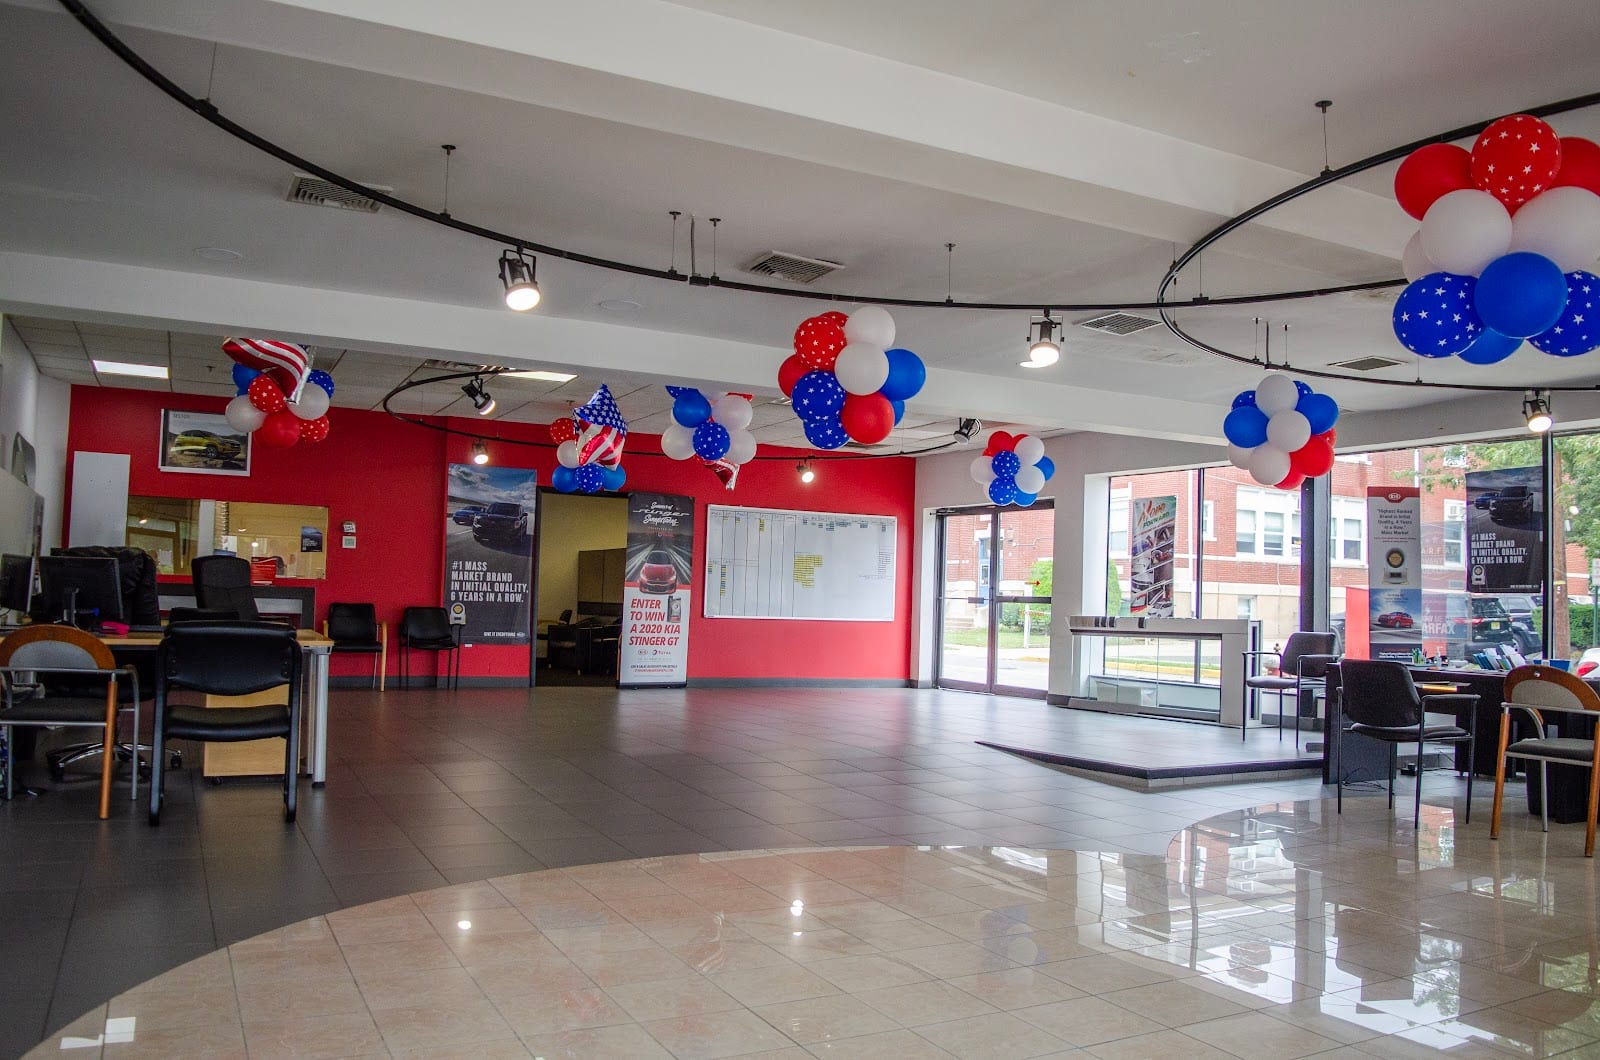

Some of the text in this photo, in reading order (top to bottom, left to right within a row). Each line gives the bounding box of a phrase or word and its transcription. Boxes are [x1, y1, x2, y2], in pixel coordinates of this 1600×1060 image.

[452, 561, 488, 571] #1 MASS
[452, 571, 512, 582] MARKET BRAND
[451, 581, 528, 593] IN INITIAL QUALITY,
[451, 592, 524, 602] 6 YEARS IN A ROW.
[631, 599, 661, 609] ENTER
[631, 611, 665, 621] TO WIN
[630, 624, 680, 634] A 2020 KIA
[1422, 623, 1456, 634] ARFAX
[629, 636, 679, 646] STINGER GT
